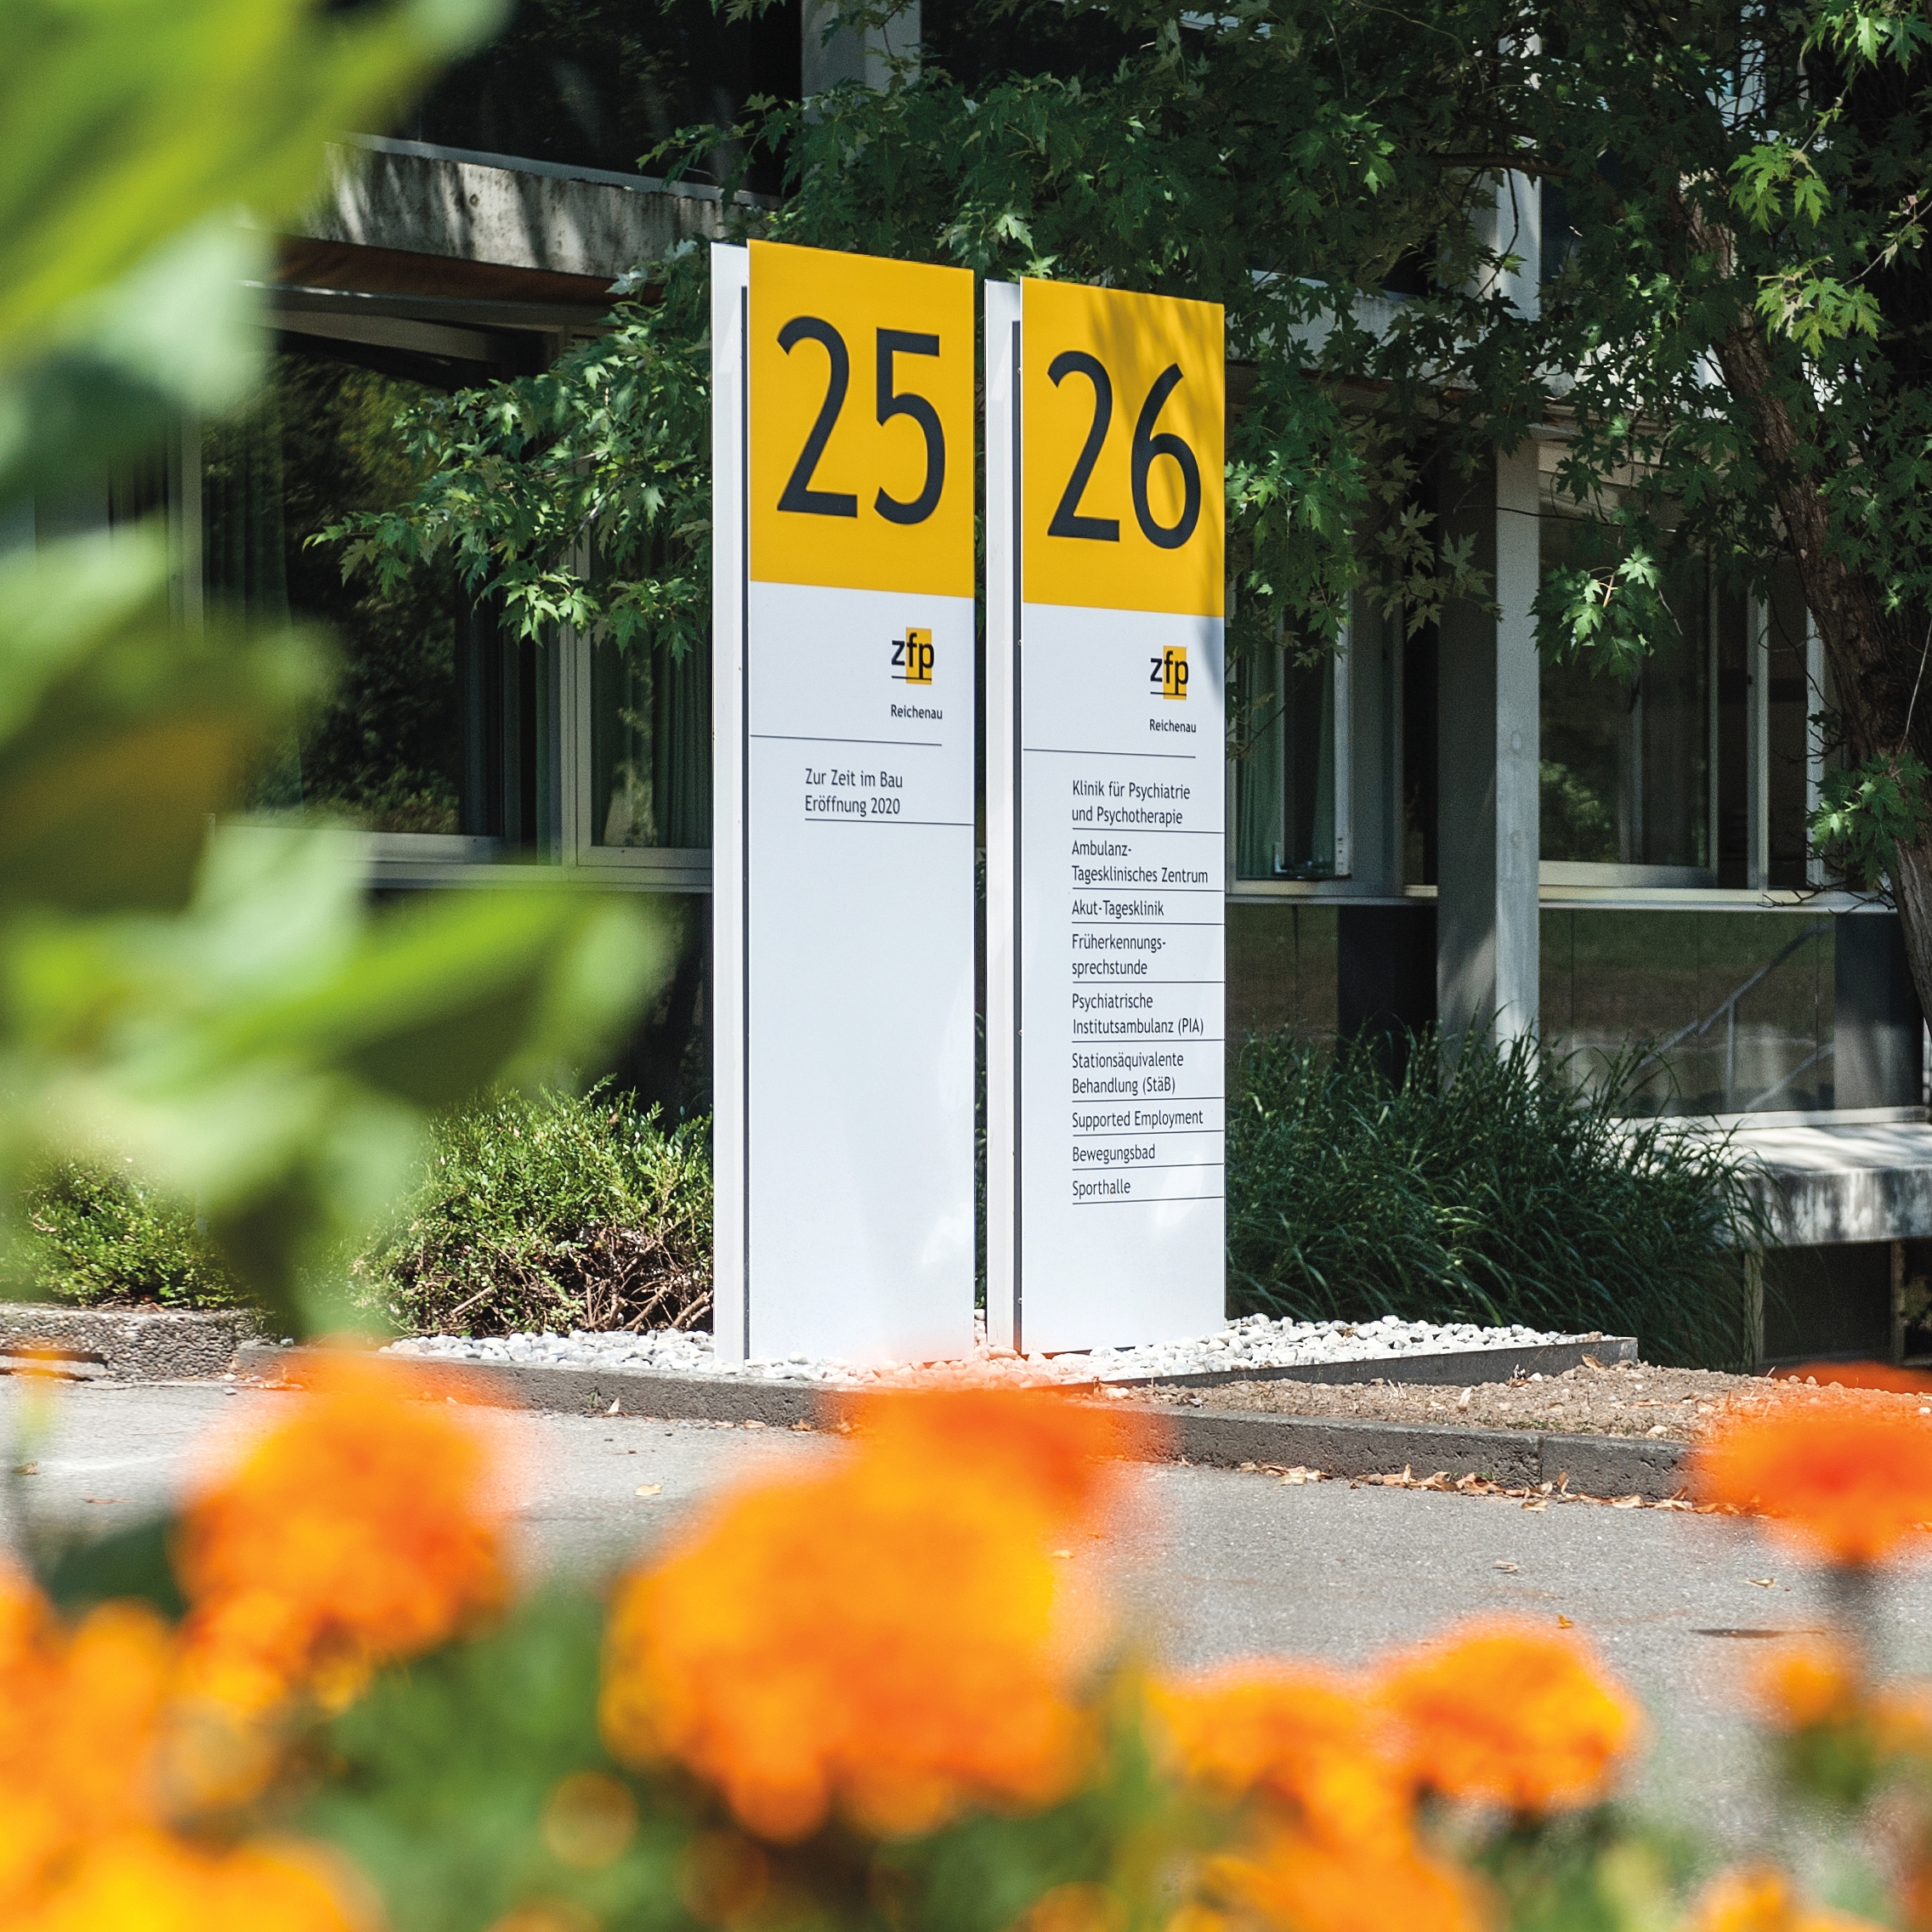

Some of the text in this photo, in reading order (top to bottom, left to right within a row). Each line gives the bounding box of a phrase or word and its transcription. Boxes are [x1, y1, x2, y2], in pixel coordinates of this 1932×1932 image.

[778, 317, 944, 524] 25
[1048, 351, 1201, 549] 26
[892, 632, 934, 681] zfp
[1151, 651, 1188, 696] zfp
[891, 705, 943, 719] Reichenau
[1150, 719, 1196, 733] Reichenau
[806, 768, 902, 788] Zur Zeit im Bau
[1074, 780, 1190, 802] Klinik für Psychiatrie
[806, 795, 900, 817] Eröffnung 2020
[1073, 806, 1182, 827] und Psychotherapie
[1072, 840, 1131, 856] Ambulanz-
[1072, 865, 1208, 885] Tagesklinisches Zentrum
[1072, 899, 1164, 919] Akut-Tagesklinik
[1073, 933, 1165, 953] Früherkennungs-
[1073, 959, 1147, 977] sprechstunde
[1073, 993, 1153, 1012] Psychiatrische
[1074, 1018, 1204, 1035] Institutsambulanz (PIA)
[1073, 1051, 1183, 1071] Stationsäquivalente
[1073, 1076, 1175, 1096] Behandlung (StäB)
[1073, 1110, 1203, 1130] Supported Employment
[1073, 1144, 1154, 1164] Bewegungsbad
[1073, 1179, 1130, 1199] Sporthalle
